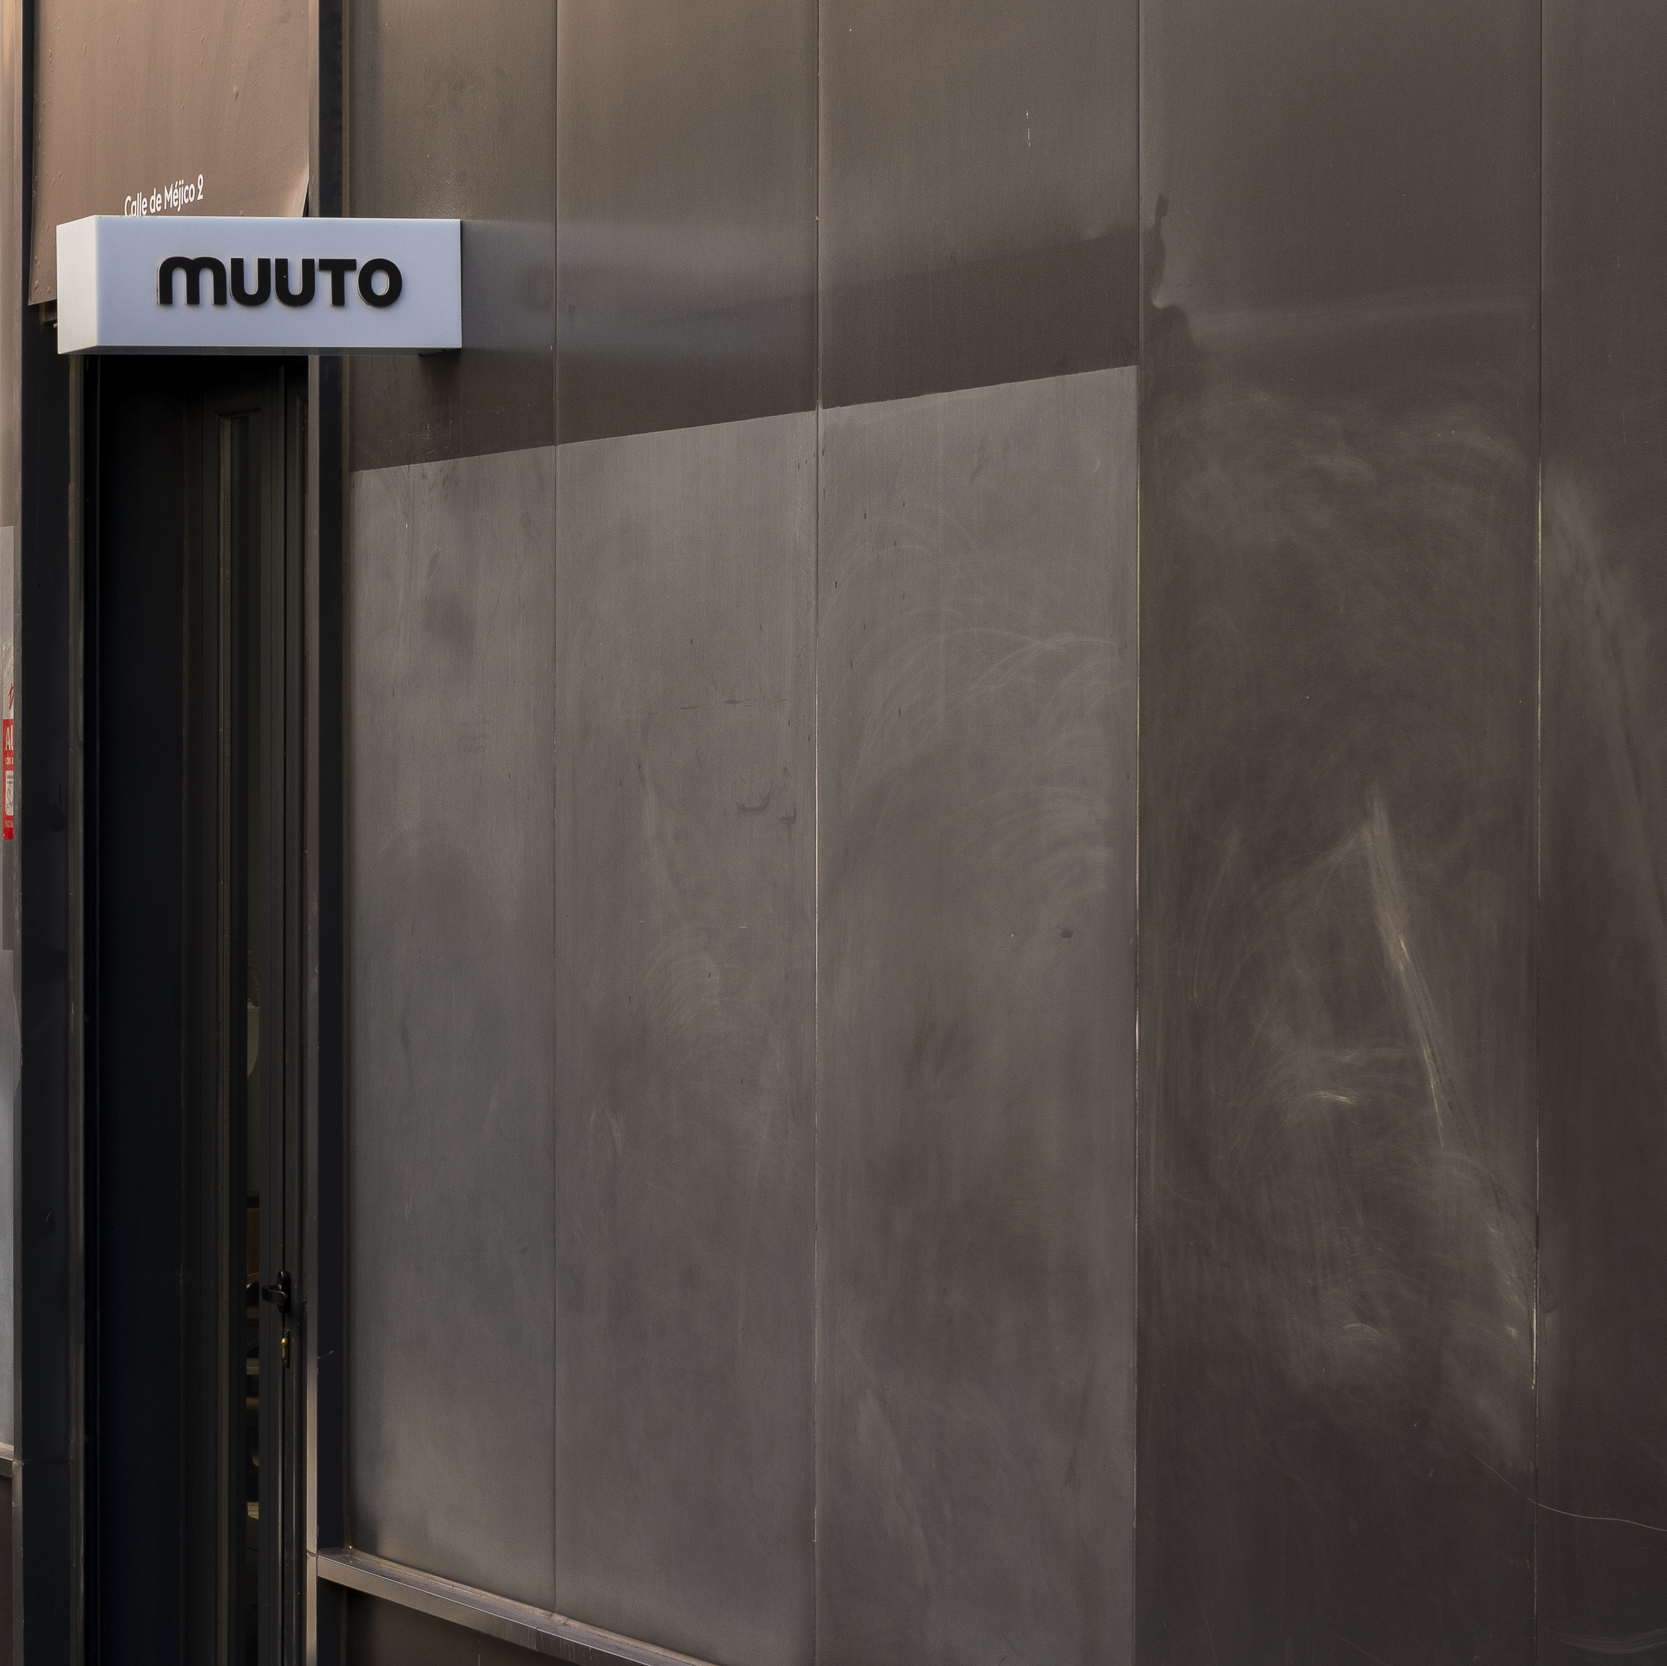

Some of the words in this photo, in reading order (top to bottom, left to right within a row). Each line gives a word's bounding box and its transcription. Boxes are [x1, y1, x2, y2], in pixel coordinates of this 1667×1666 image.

[124, 192, 148, 216] Calle
[149, 187, 162, 213] de
[164, 179, 195, 212] Méjico
[197, 173, 204, 200] 2
